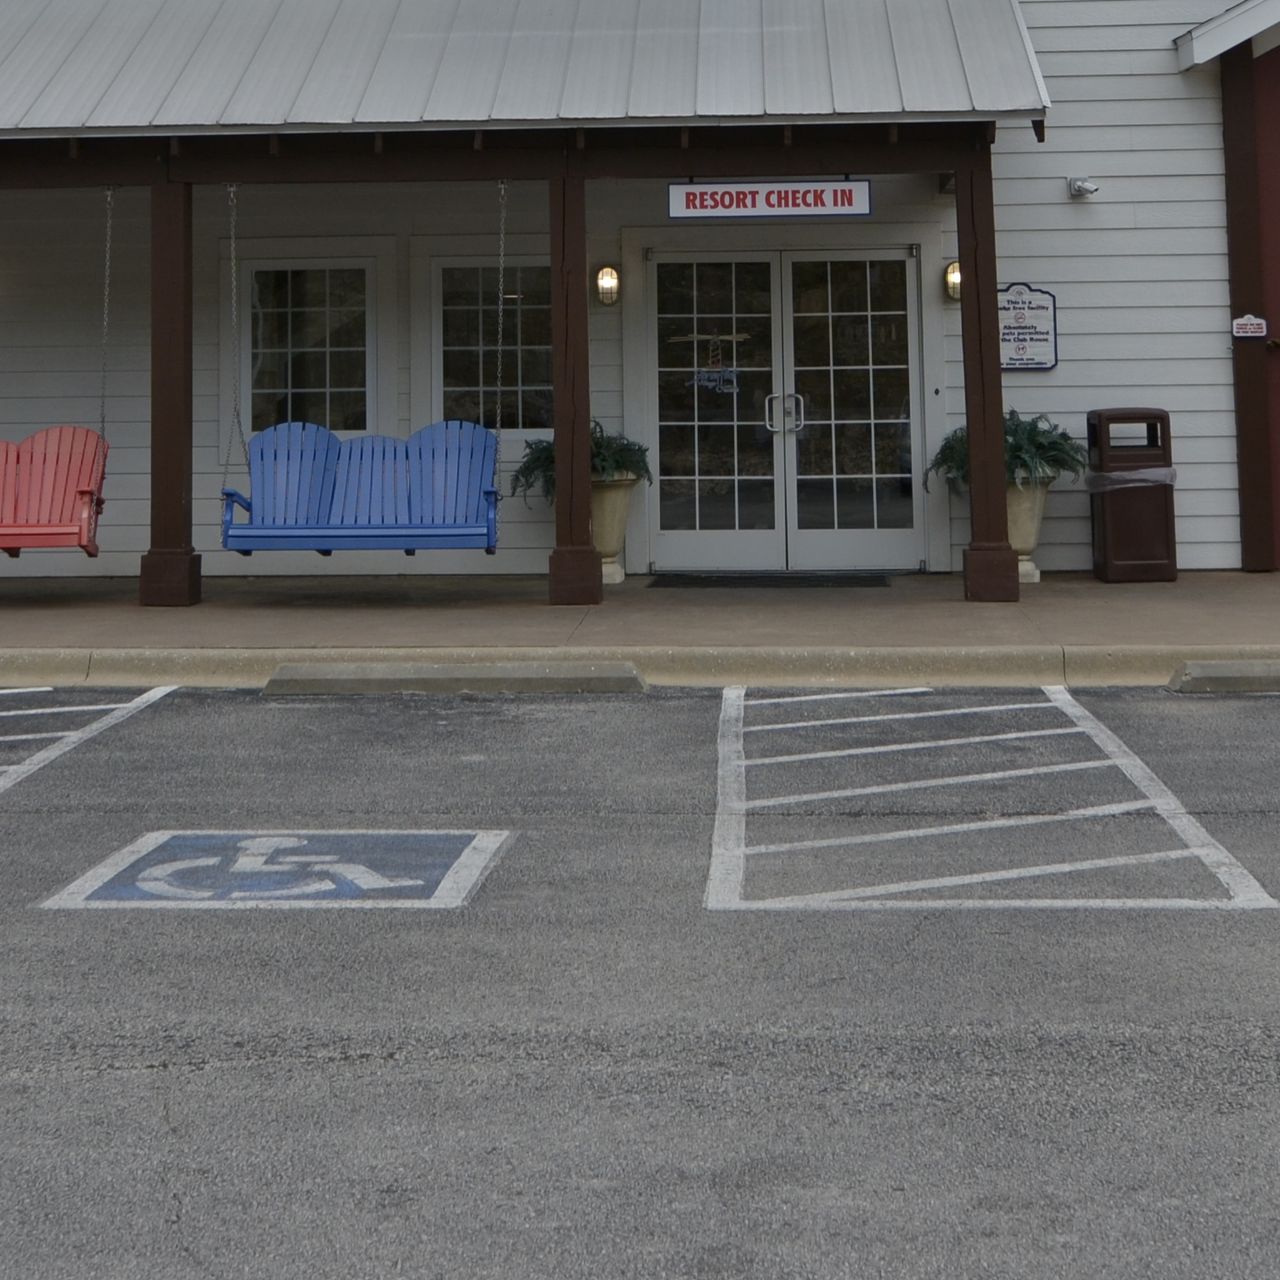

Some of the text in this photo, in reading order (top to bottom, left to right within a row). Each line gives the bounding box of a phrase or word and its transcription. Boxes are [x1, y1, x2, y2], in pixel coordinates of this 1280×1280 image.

[685, 189, 854, 210] RESORT CHECK IN
